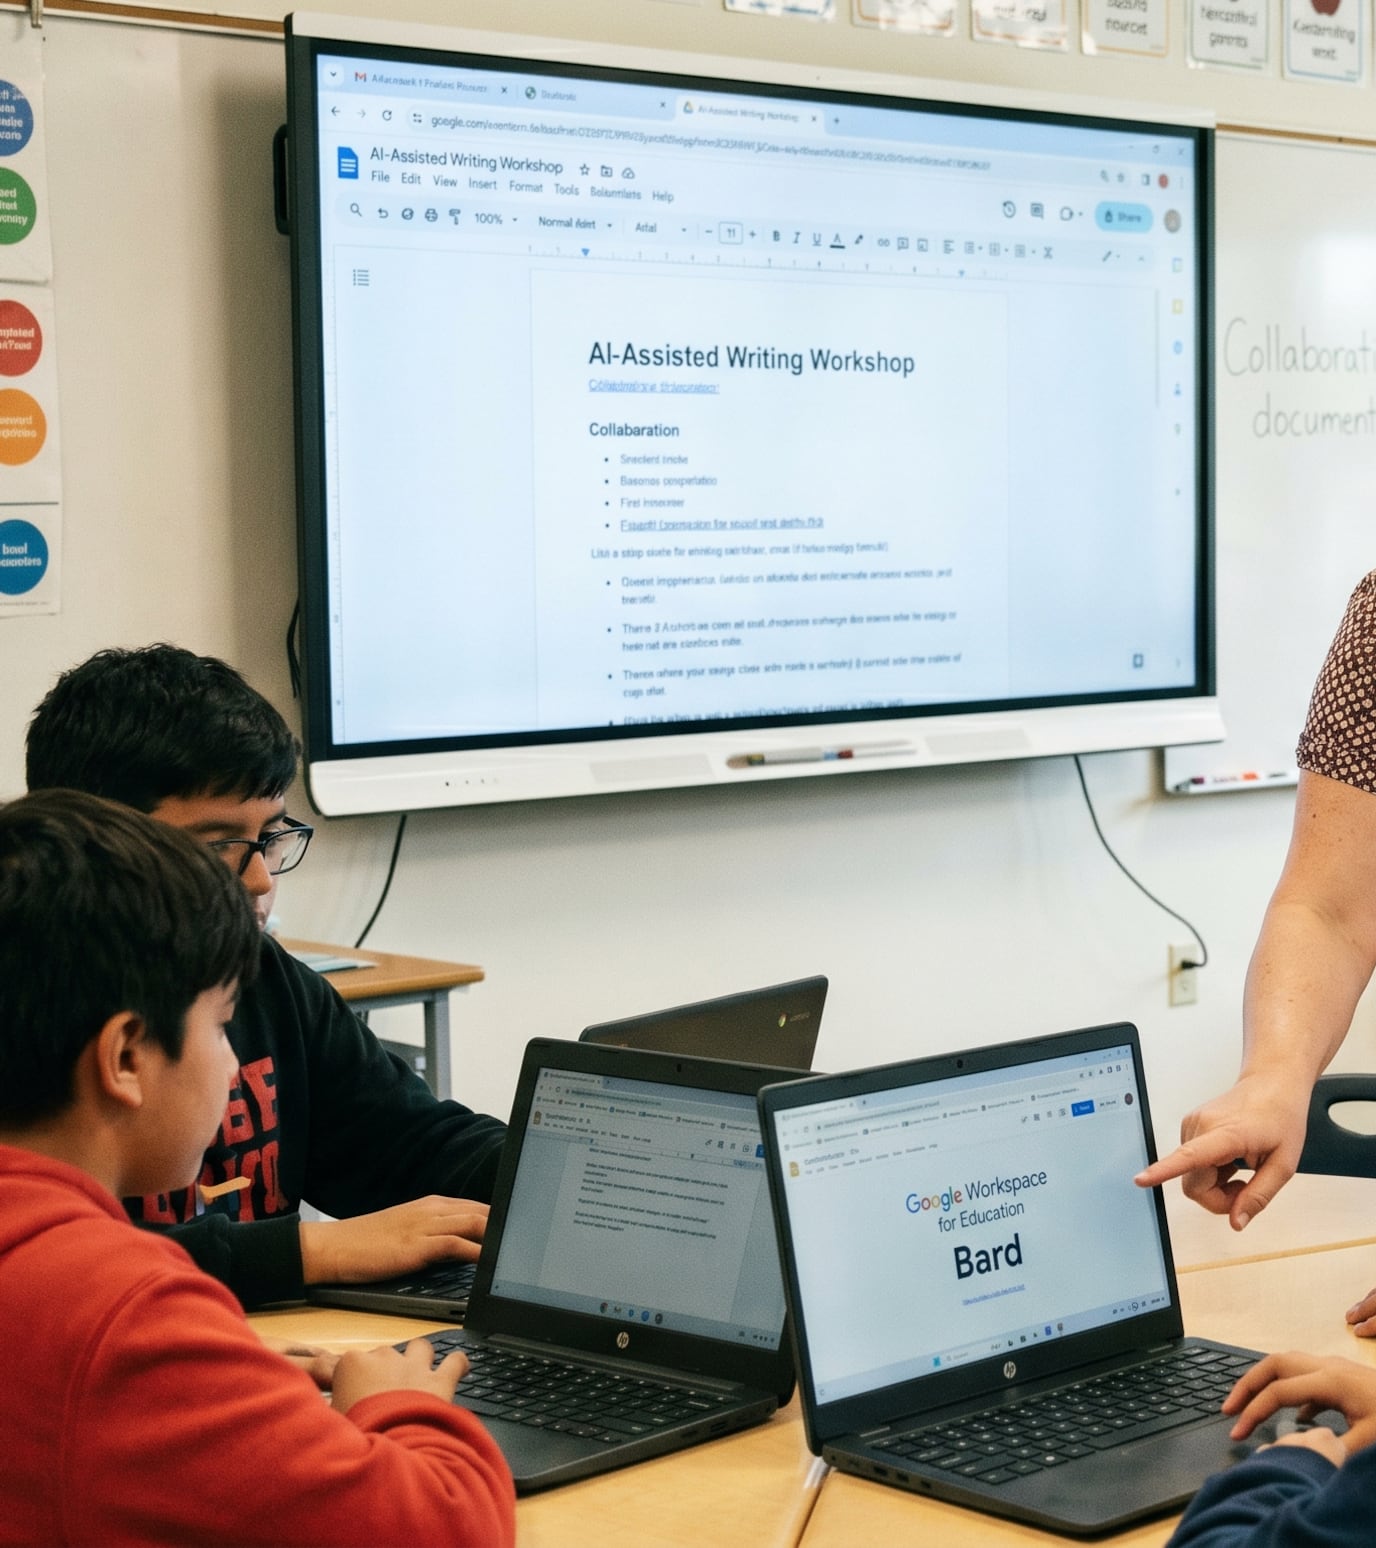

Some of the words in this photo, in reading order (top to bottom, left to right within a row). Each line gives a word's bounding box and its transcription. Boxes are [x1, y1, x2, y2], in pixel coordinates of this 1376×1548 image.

[370, 147, 447, 165] AI-Assisted
[450, 152, 498, 173] Writing
[500, 156, 564, 176] Workshop
[371, 170, 391, 183] File
[401, 172, 422, 185] Edit
[433, 175, 458, 187] View
[468, 177, 498, 190] Insert
[509, 180, 544, 193] Format
[554, 183, 580, 196] Tools
[652, 190, 675, 203] Help
[474, 213, 503, 225] 100%
[538, 216, 574, 228] Normal
[588, 342, 719, 368] AI-Assisted
[726, 345, 803, 375] Writing
[810, 348, 915, 378] Workshop
[905, 1186, 963, 1214] Google
[965, 1171, 1047, 1201] Workspace
[938, 1217, 957, 1232] for
[959, 1202, 1025, 1228] Education
[953, 1233, 1023, 1280] Bard
